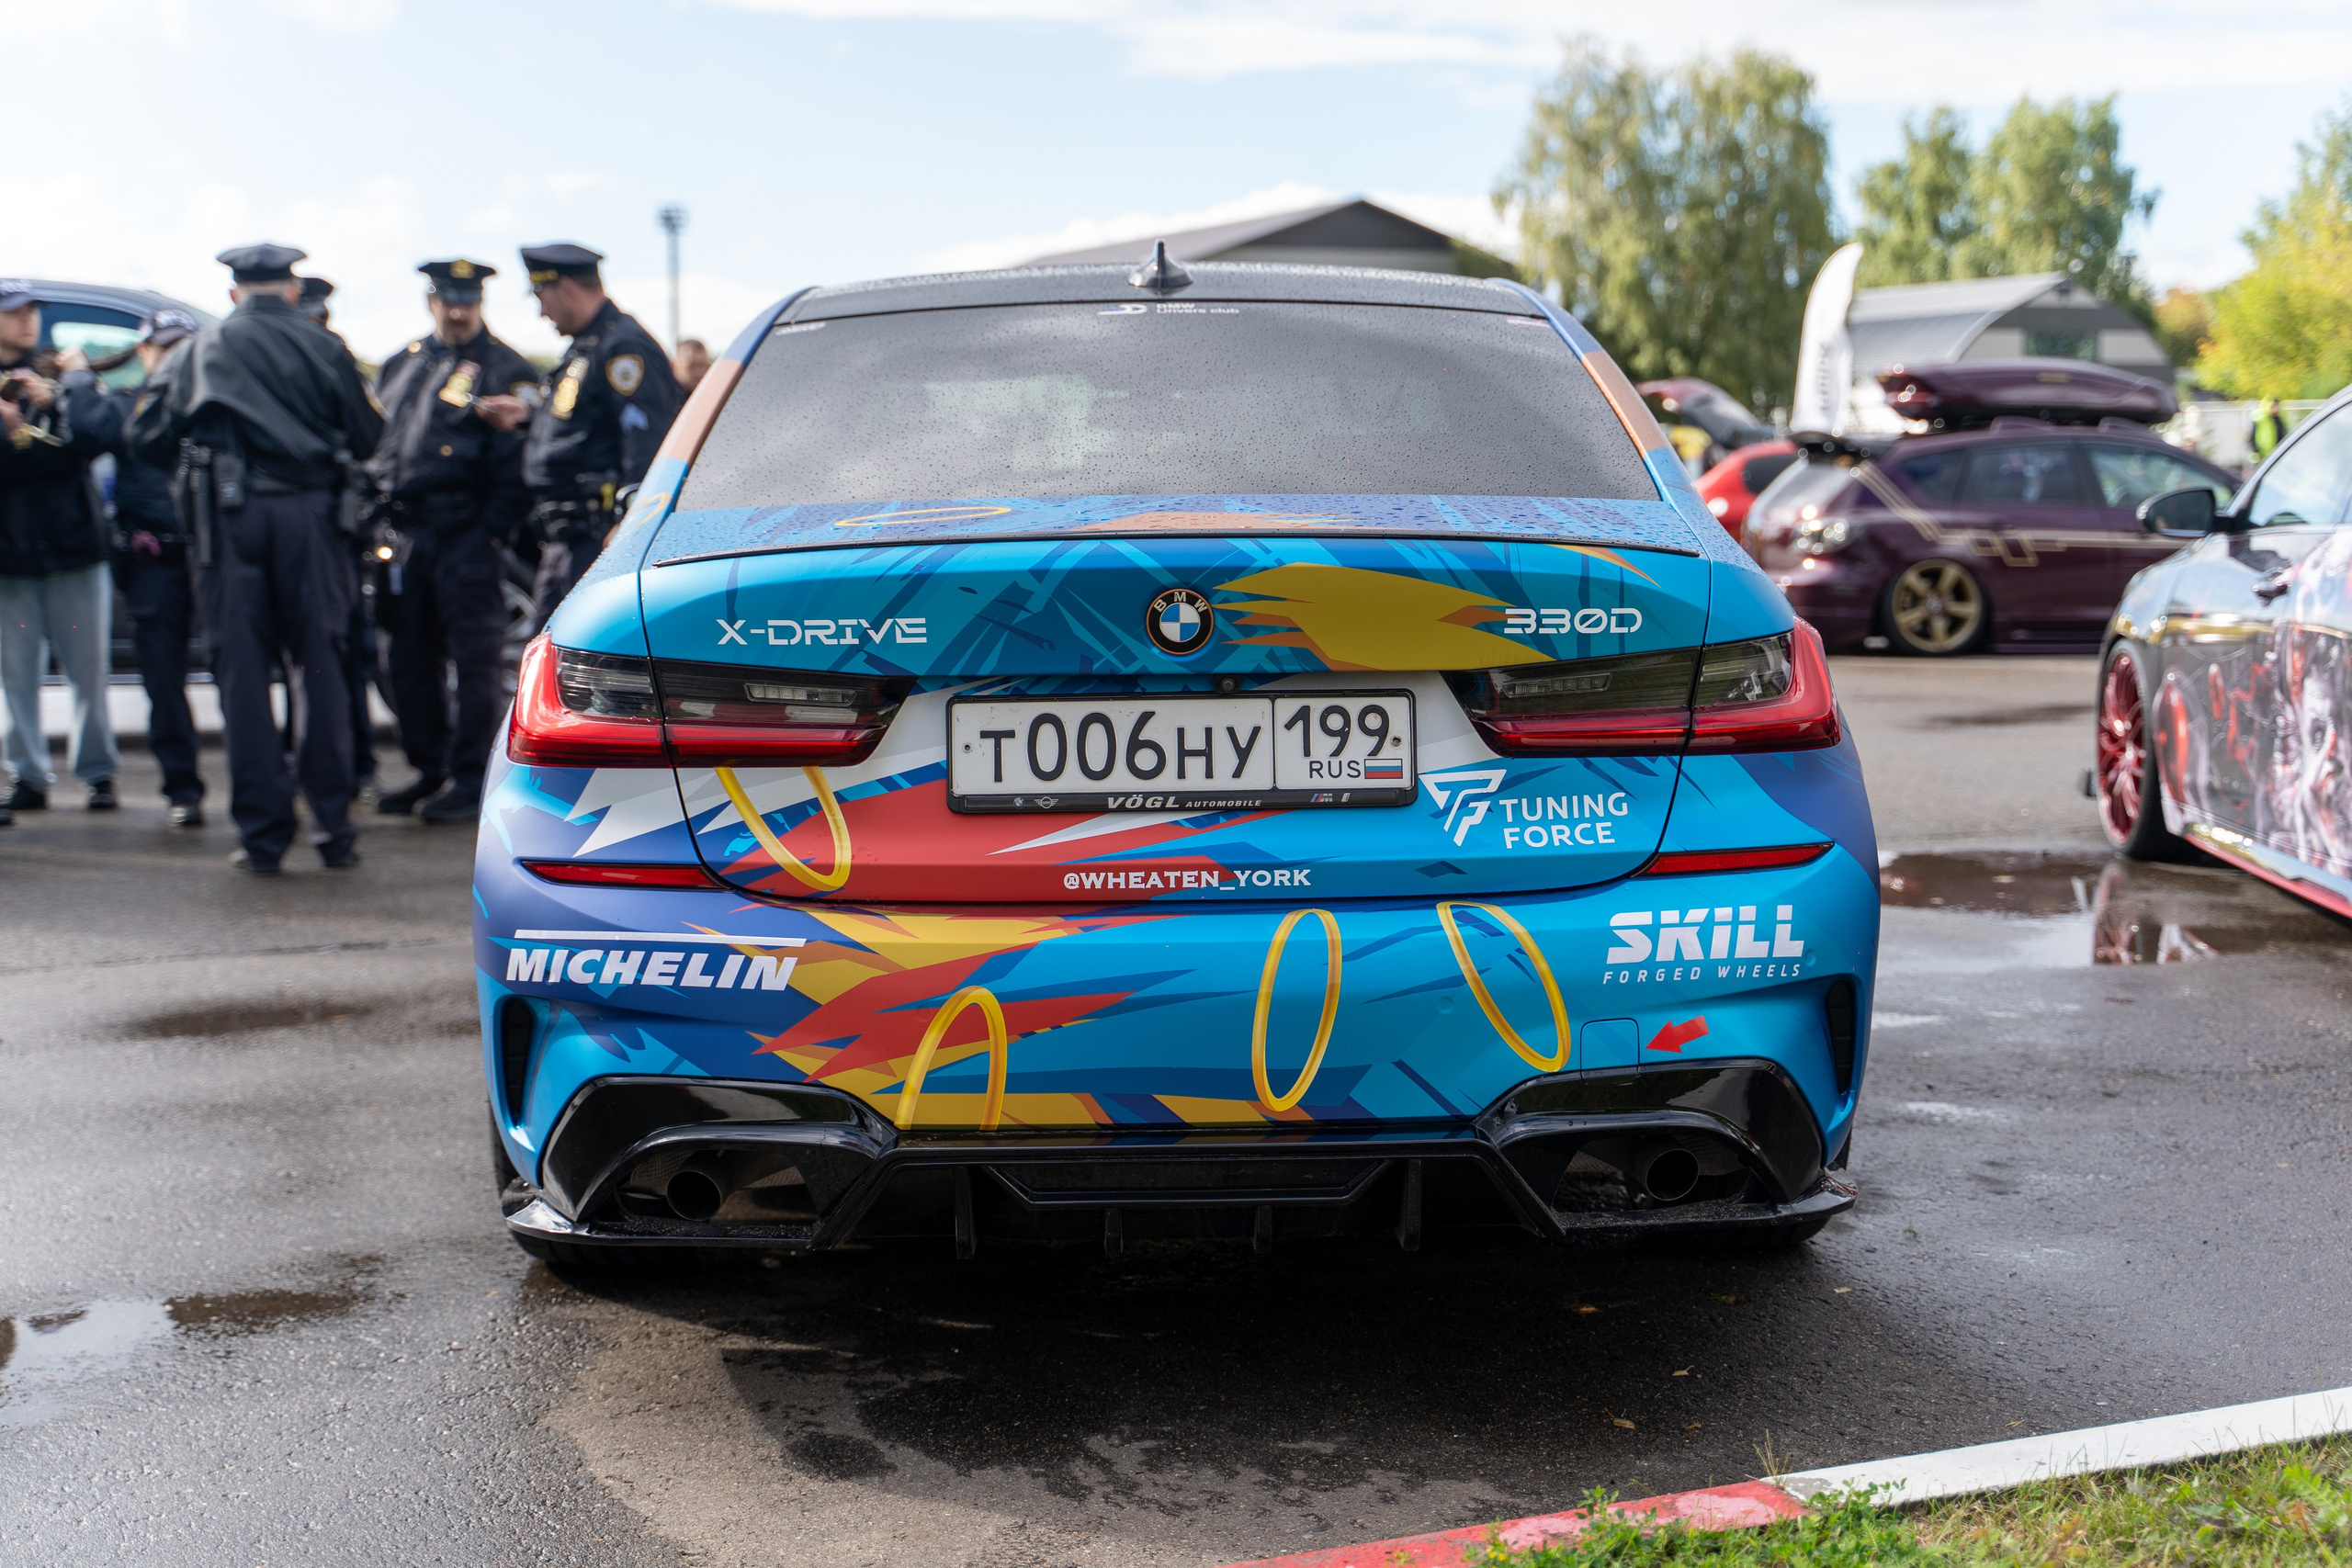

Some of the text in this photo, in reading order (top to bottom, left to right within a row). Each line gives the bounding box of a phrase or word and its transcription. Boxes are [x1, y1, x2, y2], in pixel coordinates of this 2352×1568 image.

[1153, 592, 1208, 614] BMW
[716, 617, 928, 646] X-DRIVE
[1504, 607, 1643, 635] 330D
[1283, 705, 1390, 758] 199
[1309, 760, 1362, 779] RUS
[1107, 794, 1262, 809] VÖGL AUTOMOBILE
[1498, 792, 1629, 823] TUNING
[1503, 821, 1616, 850] FORCE
[1063, 869, 1311, 891] @WHEATEN_YORK
[1606, 904, 1804, 964] SKILL
[505, 948, 798, 991] MICHELIN
[1602, 964, 1801, 985] FORGED WHEELS
